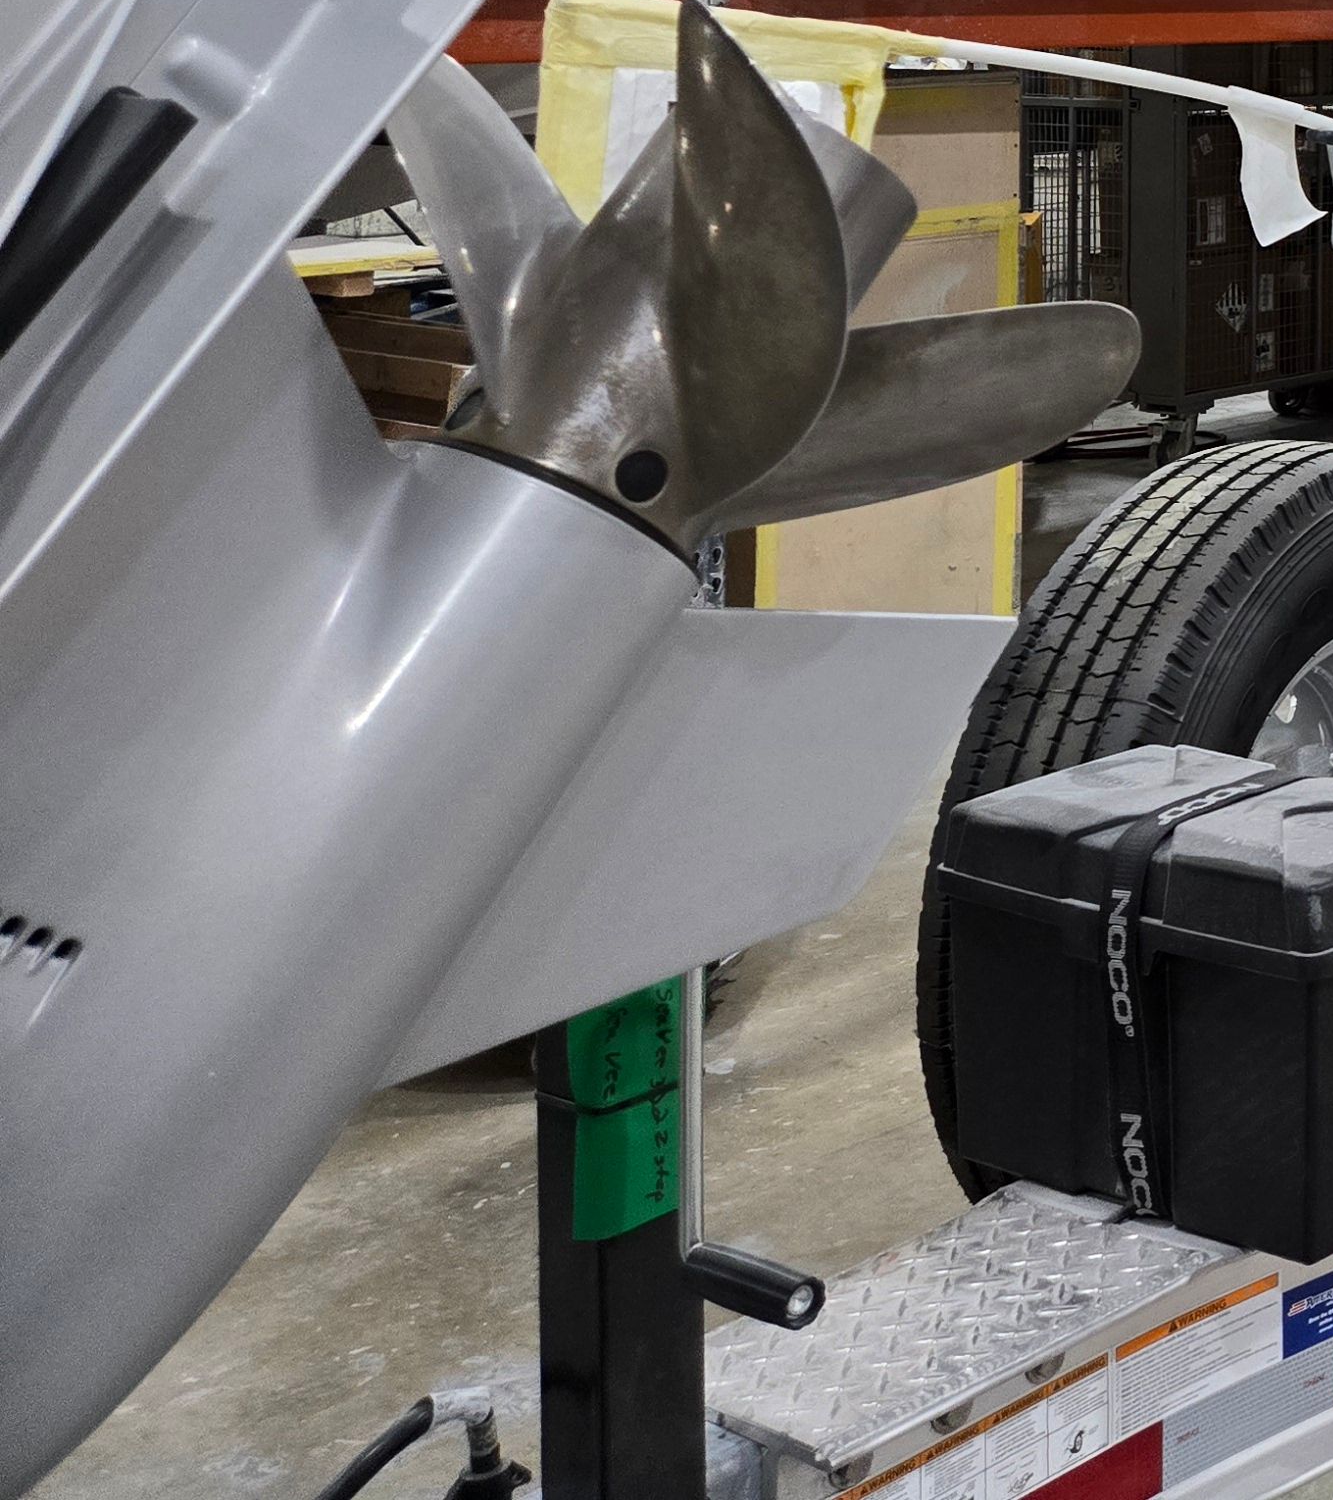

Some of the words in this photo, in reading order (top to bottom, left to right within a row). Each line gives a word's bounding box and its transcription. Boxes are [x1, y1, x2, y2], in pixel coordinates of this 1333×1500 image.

[1108, 888, 1134, 1028] NOCO
[1178, 1298, 1227, 1327] WARNING
[1063, 1358, 1107, 1386] WARNING
[1001, 1392, 1046, 1420] WARNING
[934, 1425, 982, 1454] WARNING
[867, 1461, 917, 1492] WARNING
